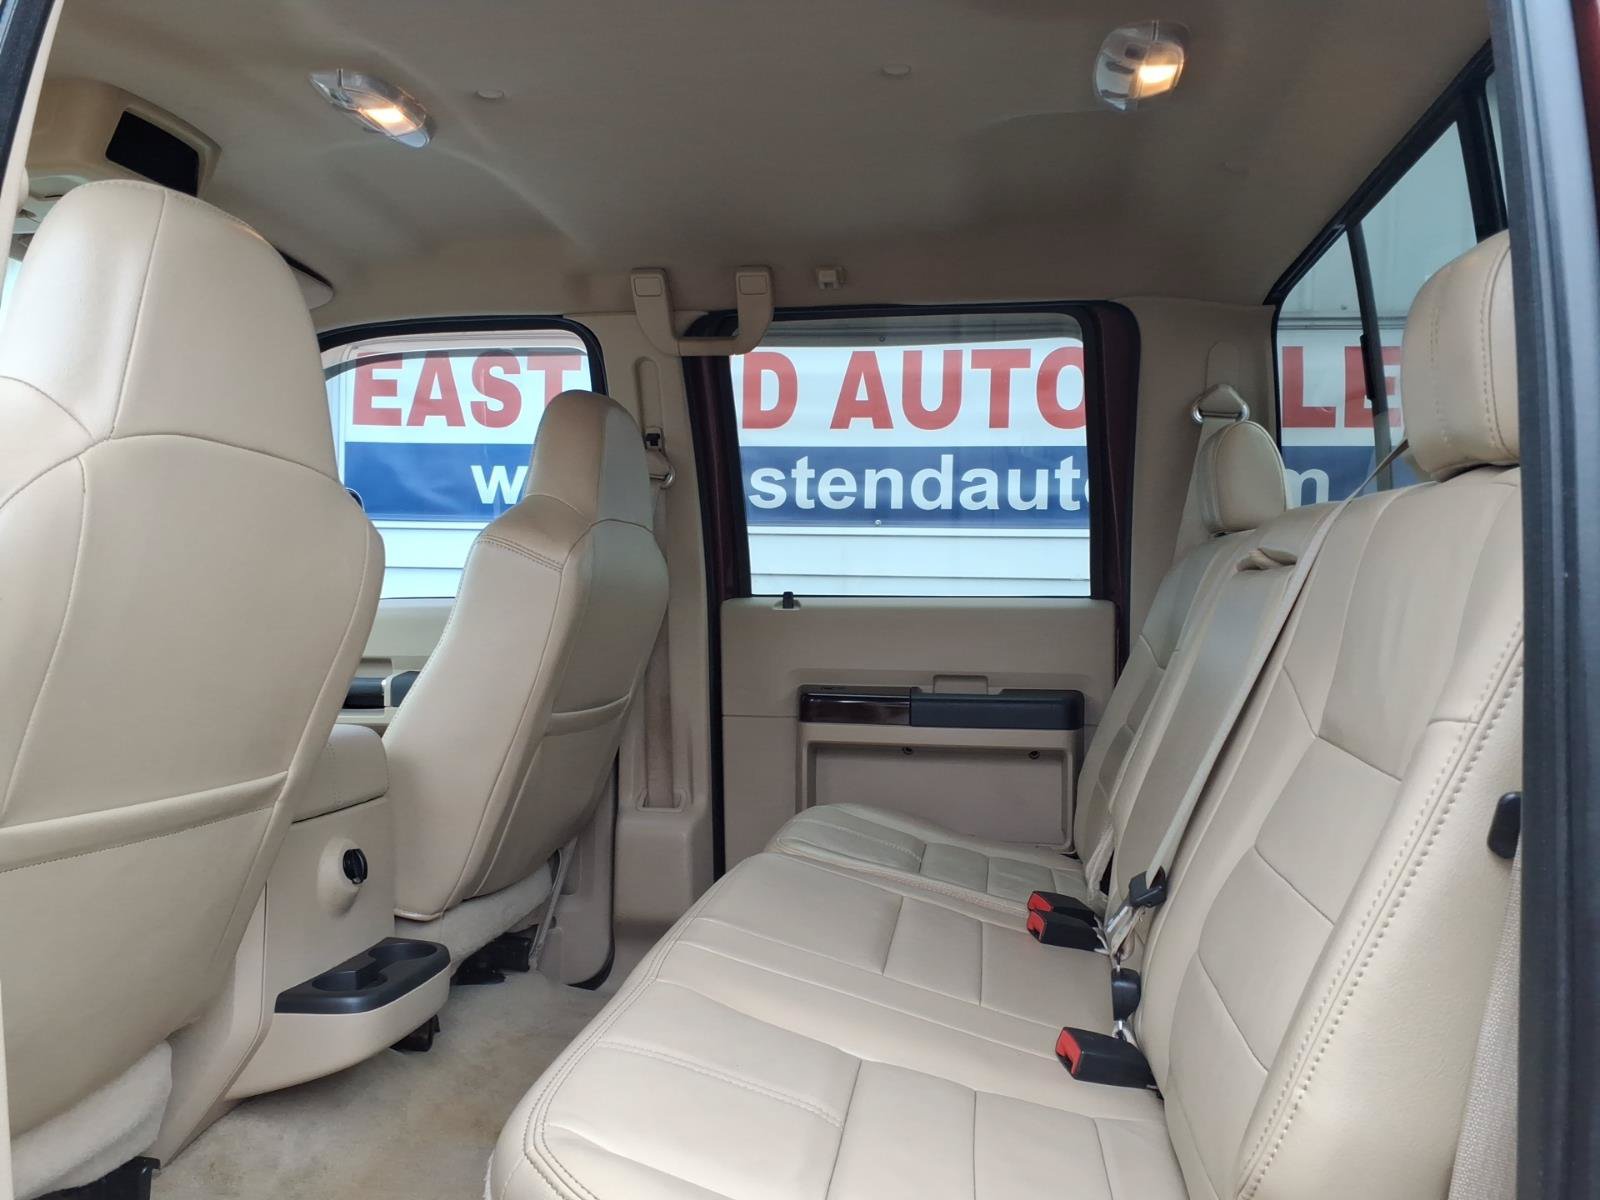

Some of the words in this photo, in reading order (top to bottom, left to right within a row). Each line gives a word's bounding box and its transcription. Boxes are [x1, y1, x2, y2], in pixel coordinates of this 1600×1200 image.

[353, 349, 582, 428] EAST
[829, 346, 1087, 430] AUTO
[748, 454, 1090, 510] stendaut
